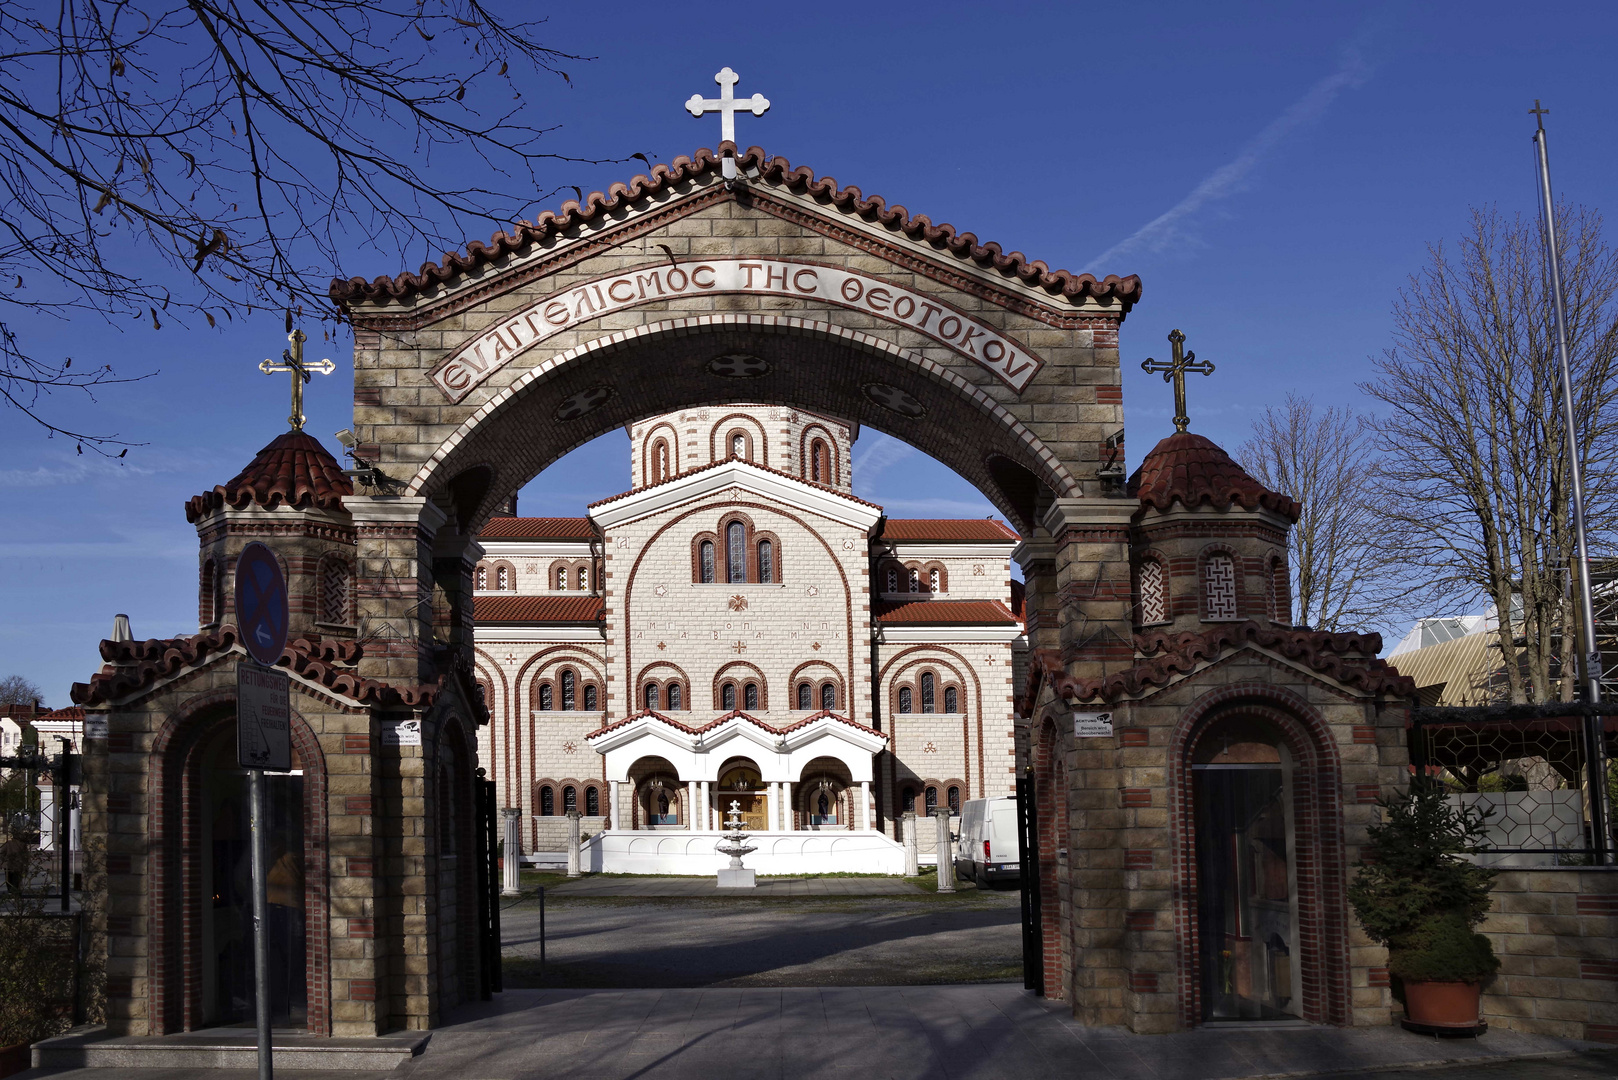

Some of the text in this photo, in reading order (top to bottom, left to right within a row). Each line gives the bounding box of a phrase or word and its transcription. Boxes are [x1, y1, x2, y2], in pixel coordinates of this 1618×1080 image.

[241, 669, 286, 692] RETTUNGSWEG
[270, 692, 287, 706] FÜR DIE
[262, 705, 287, 718] FEUERWEHR
[260, 718, 287, 731] FREIHALTEN!
